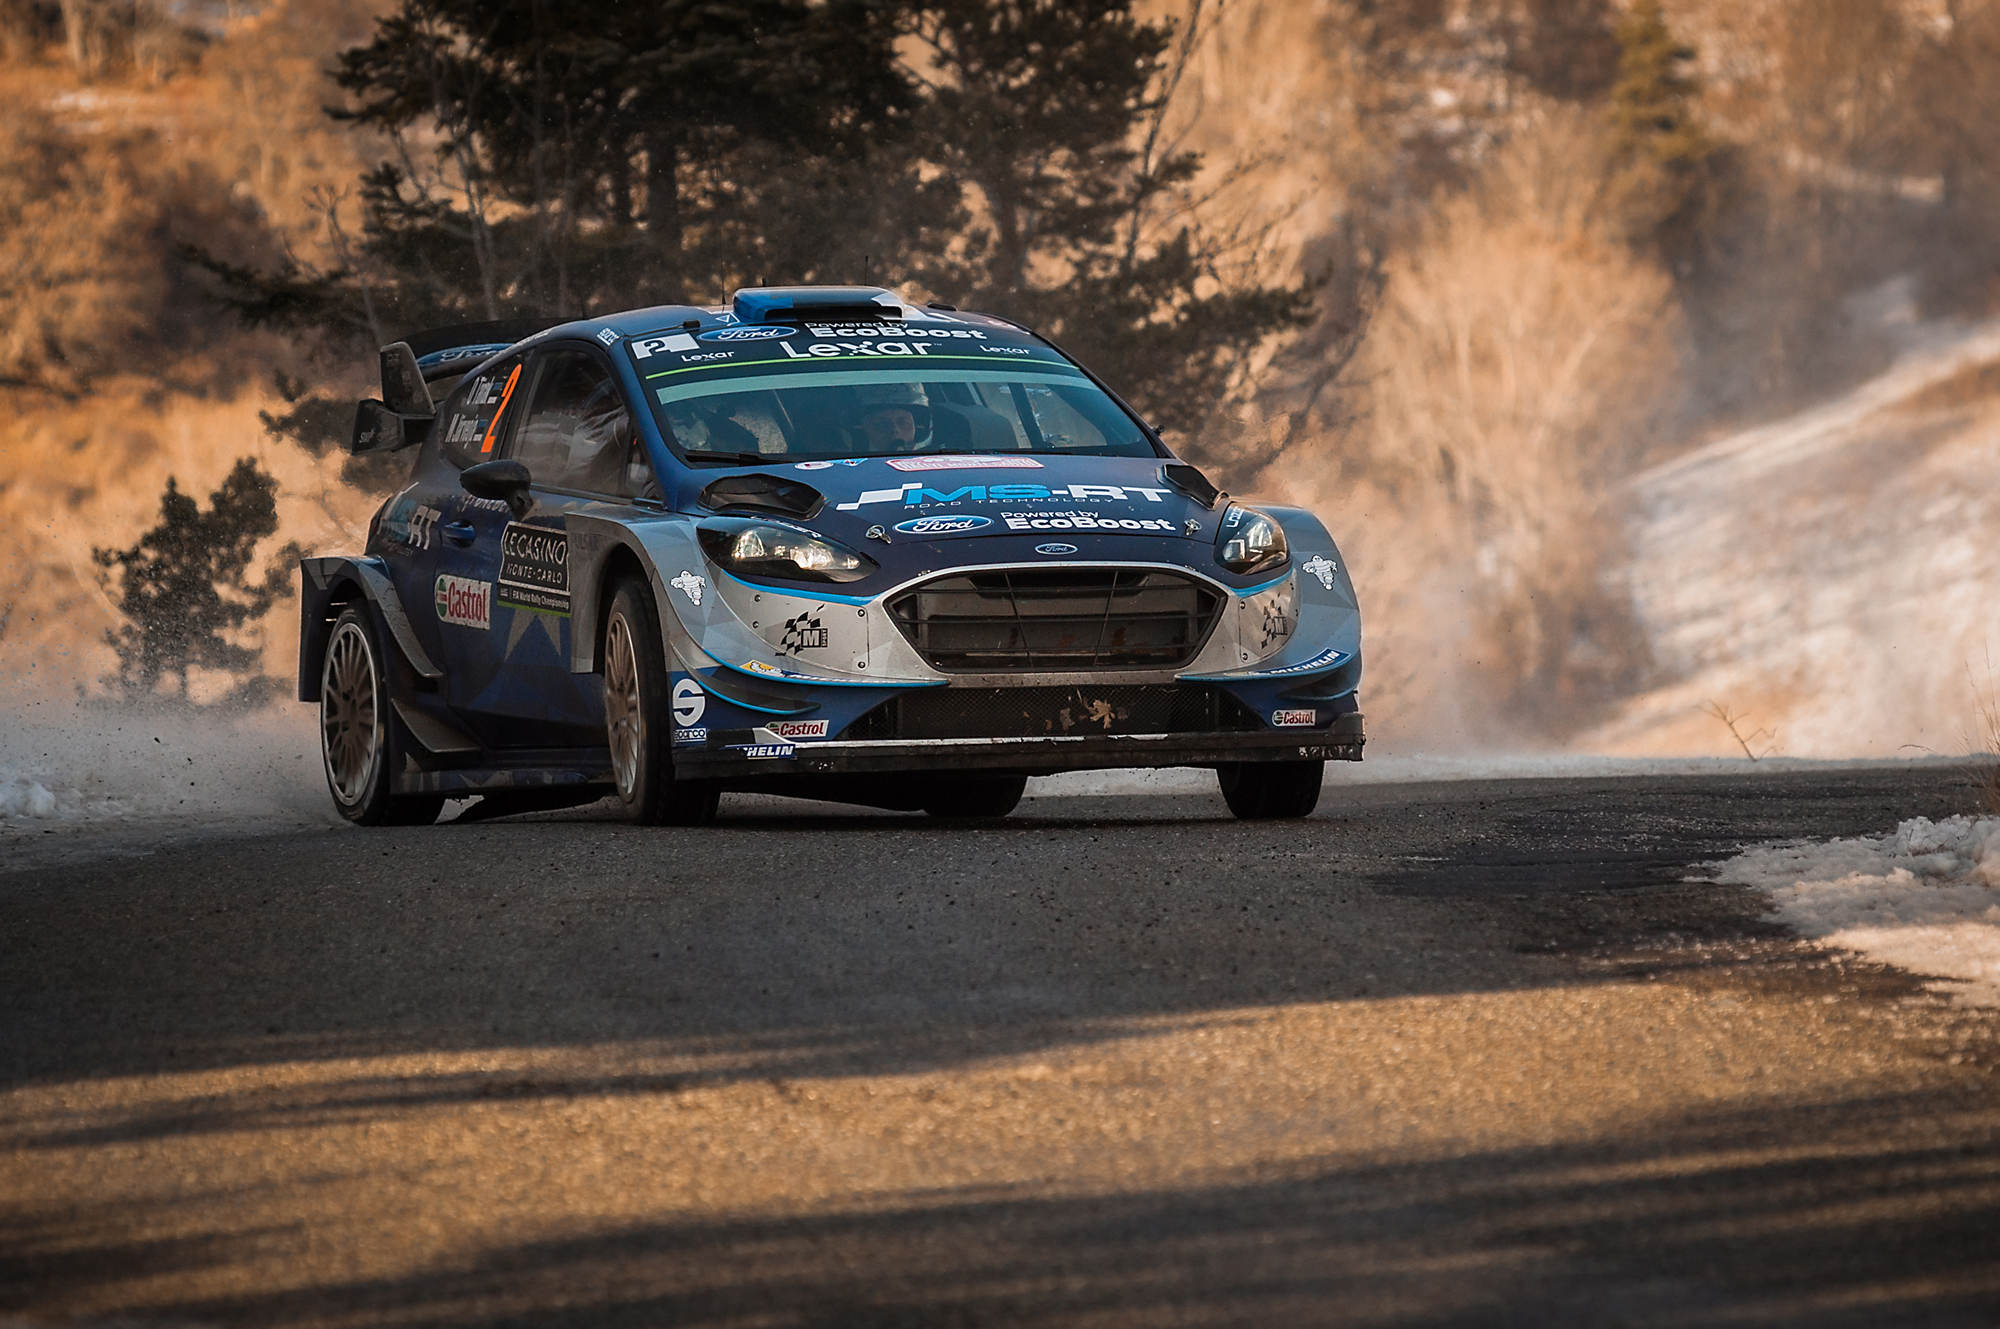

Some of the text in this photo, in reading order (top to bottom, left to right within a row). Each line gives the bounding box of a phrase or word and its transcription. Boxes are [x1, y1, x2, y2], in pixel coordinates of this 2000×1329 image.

[804, 321, 909, 330] Powered by
[717, 327, 780, 340] Ford
[809, 327, 987, 340] EcoBoost
[680, 350, 735, 362] Lexar
[779, 340, 933, 359] Lexar
[979, 344, 1030, 355] Lexar
[480, 363, 523, 453] 2
[905, 484, 1173, 504] MS-RT
[1000, 510, 1099, 519] Powered by
[913, 517, 974, 531] Ford
[1005, 516, 1177, 531] EcoBoost
[449, 582, 488, 622] Castrol
[802, 630, 820, 647] M
[1270, 650, 1341, 675] MICHELIN
[1283, 710, 1315, 725] Castrol
[779, 721, 825, 737] Castrol
[738, 745, 795, 757] HELIN
